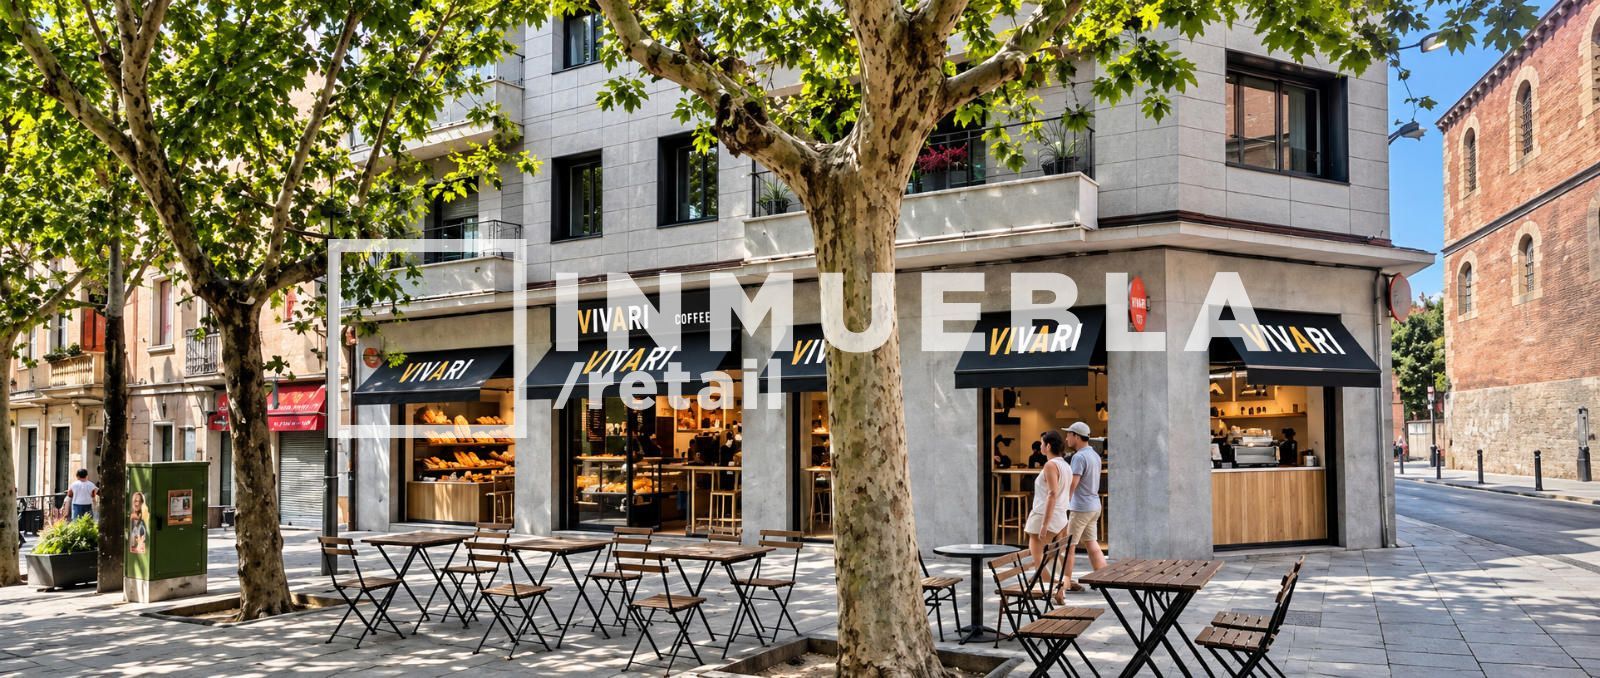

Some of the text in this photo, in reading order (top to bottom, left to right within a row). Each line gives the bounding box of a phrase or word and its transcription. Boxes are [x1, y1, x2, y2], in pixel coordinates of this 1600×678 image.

[578, 304, 711, 334] VIVARI COFFEE
[791, 338, 826, 366] VIV
[989, 323, 1083, 356] VIVARI
[1238, 322, 1347, 355] VIVARI
[399, 358, 475, 383] VIVARI
[582, 345, 678, 374] VIVARI
